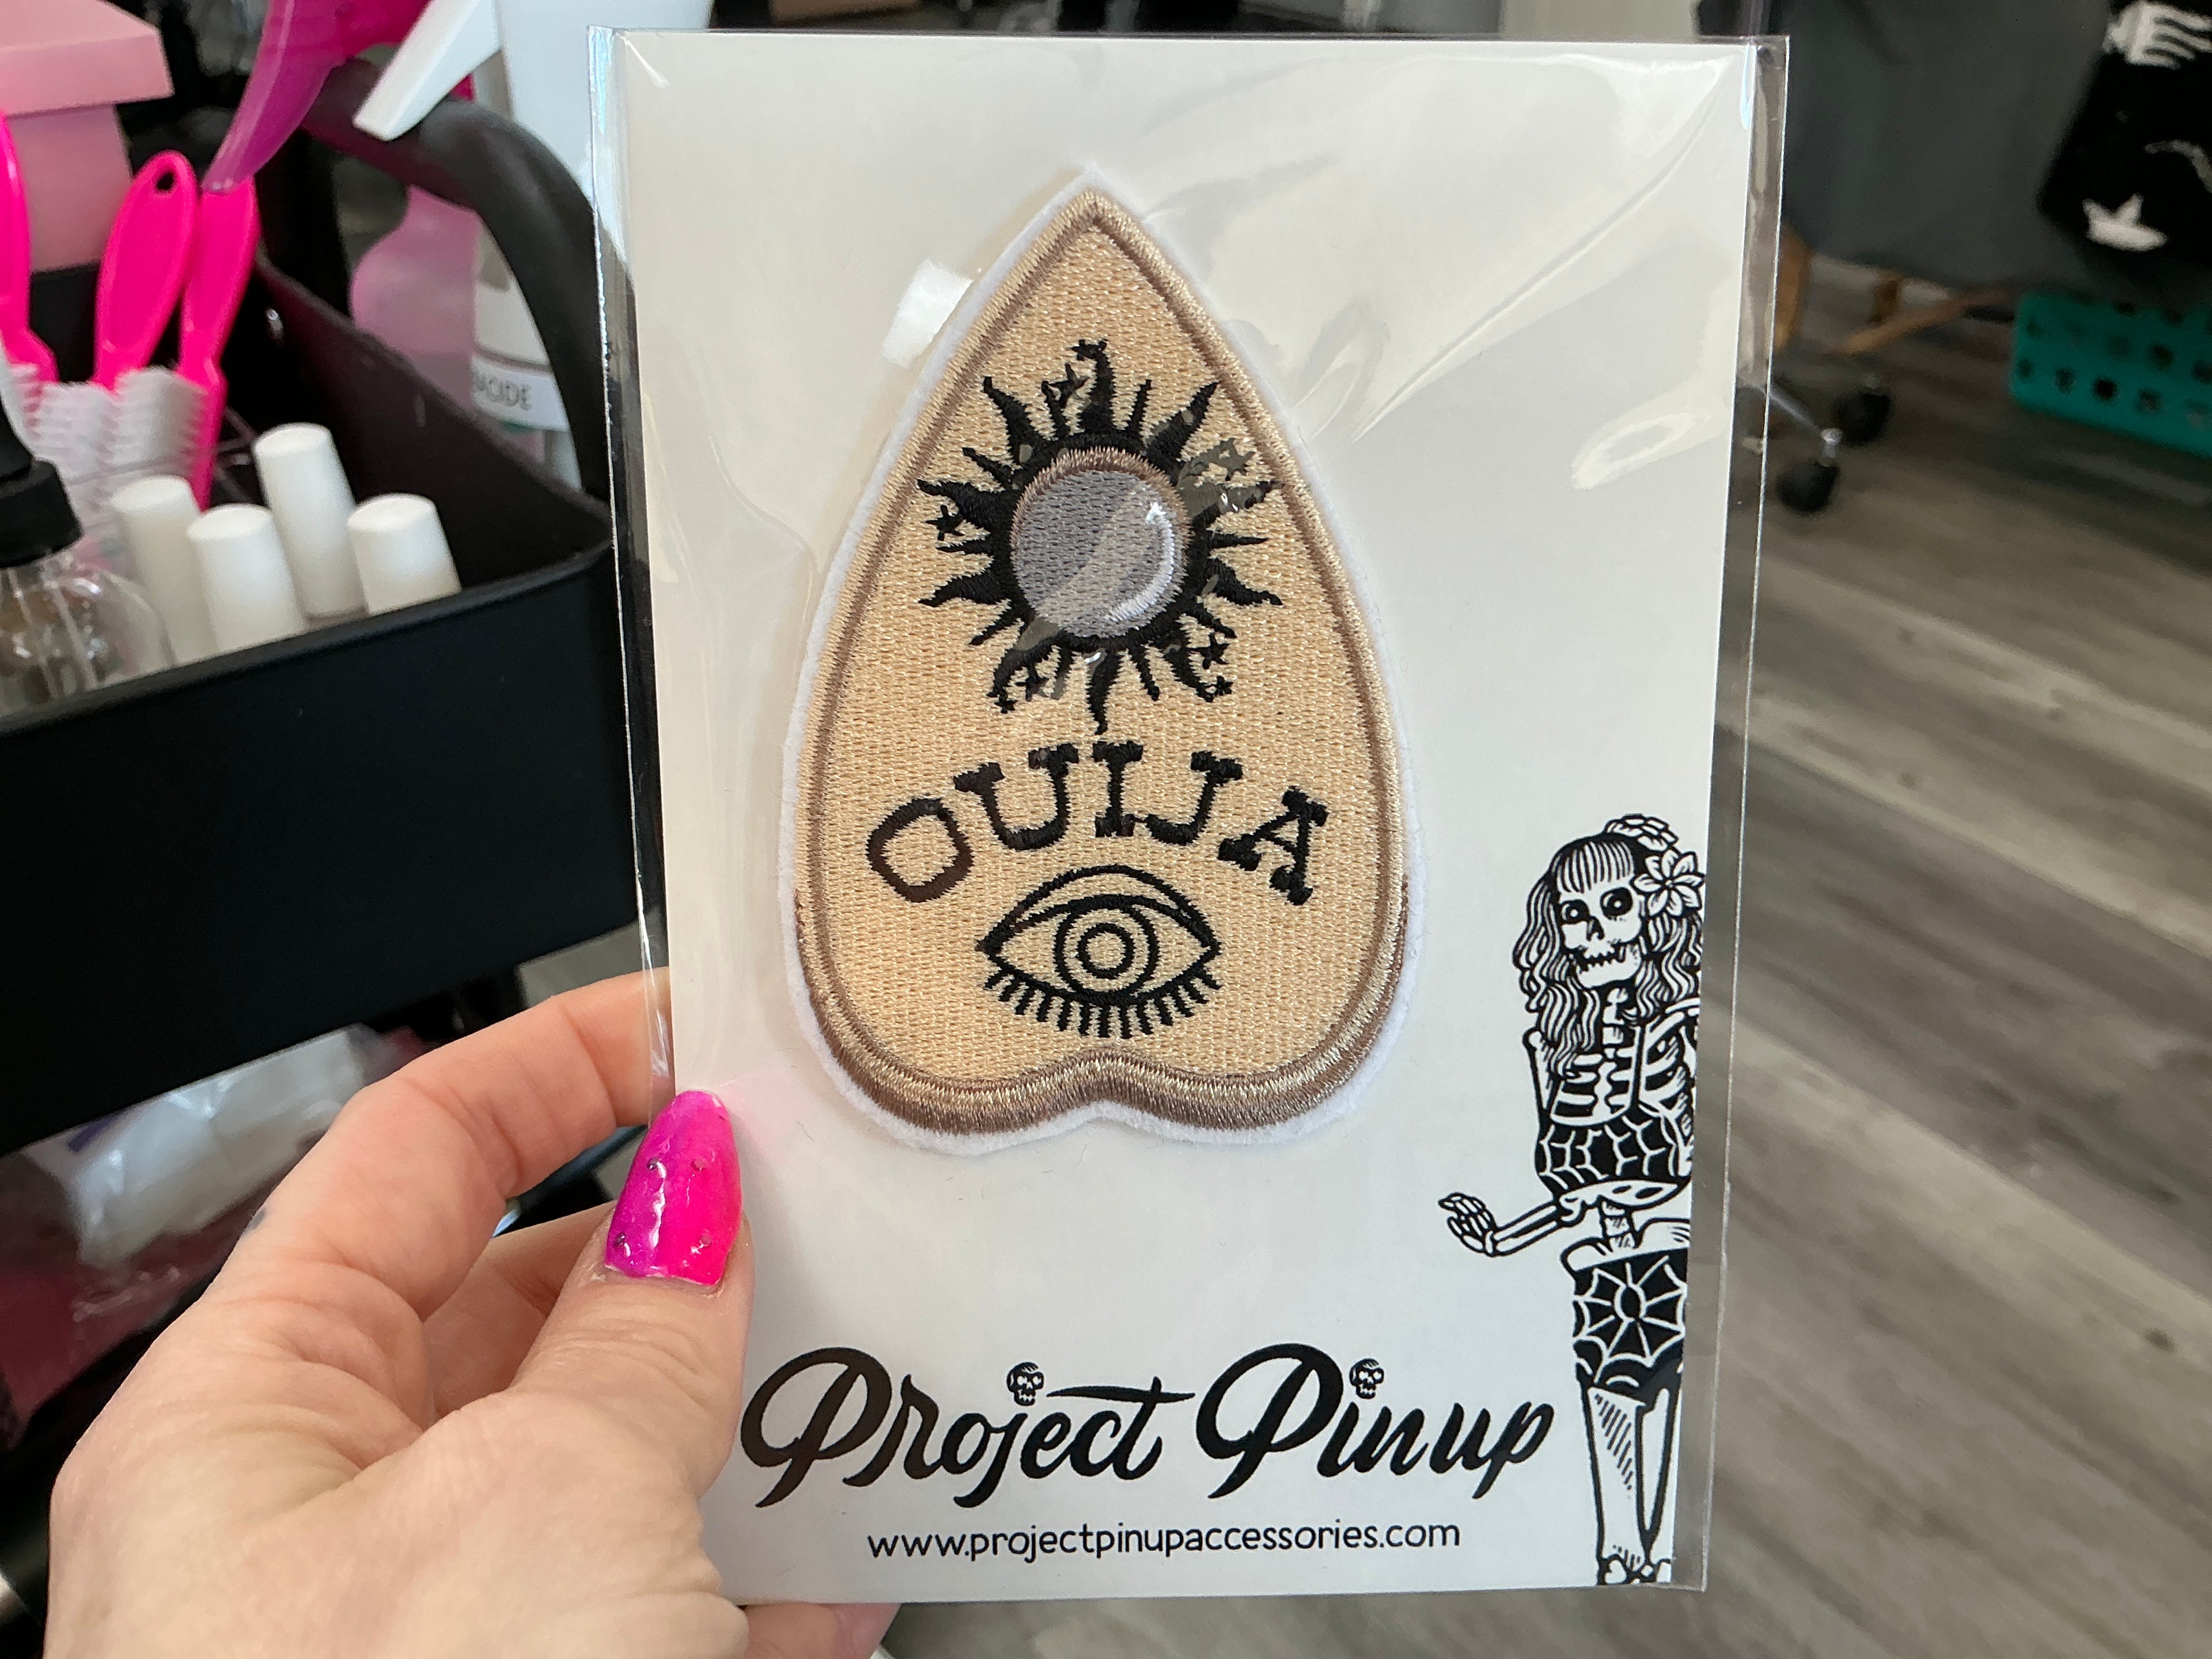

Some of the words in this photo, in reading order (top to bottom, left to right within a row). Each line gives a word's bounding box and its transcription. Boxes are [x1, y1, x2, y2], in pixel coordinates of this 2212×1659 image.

[865, 741, 1330, 906] OUIJA
[740, 1347, 1195, 1508] Project
[1196, 1343, 1554, 1499] Pinup
[867, 1519, 1460, 1563] www.projectpinupaccessories.com
